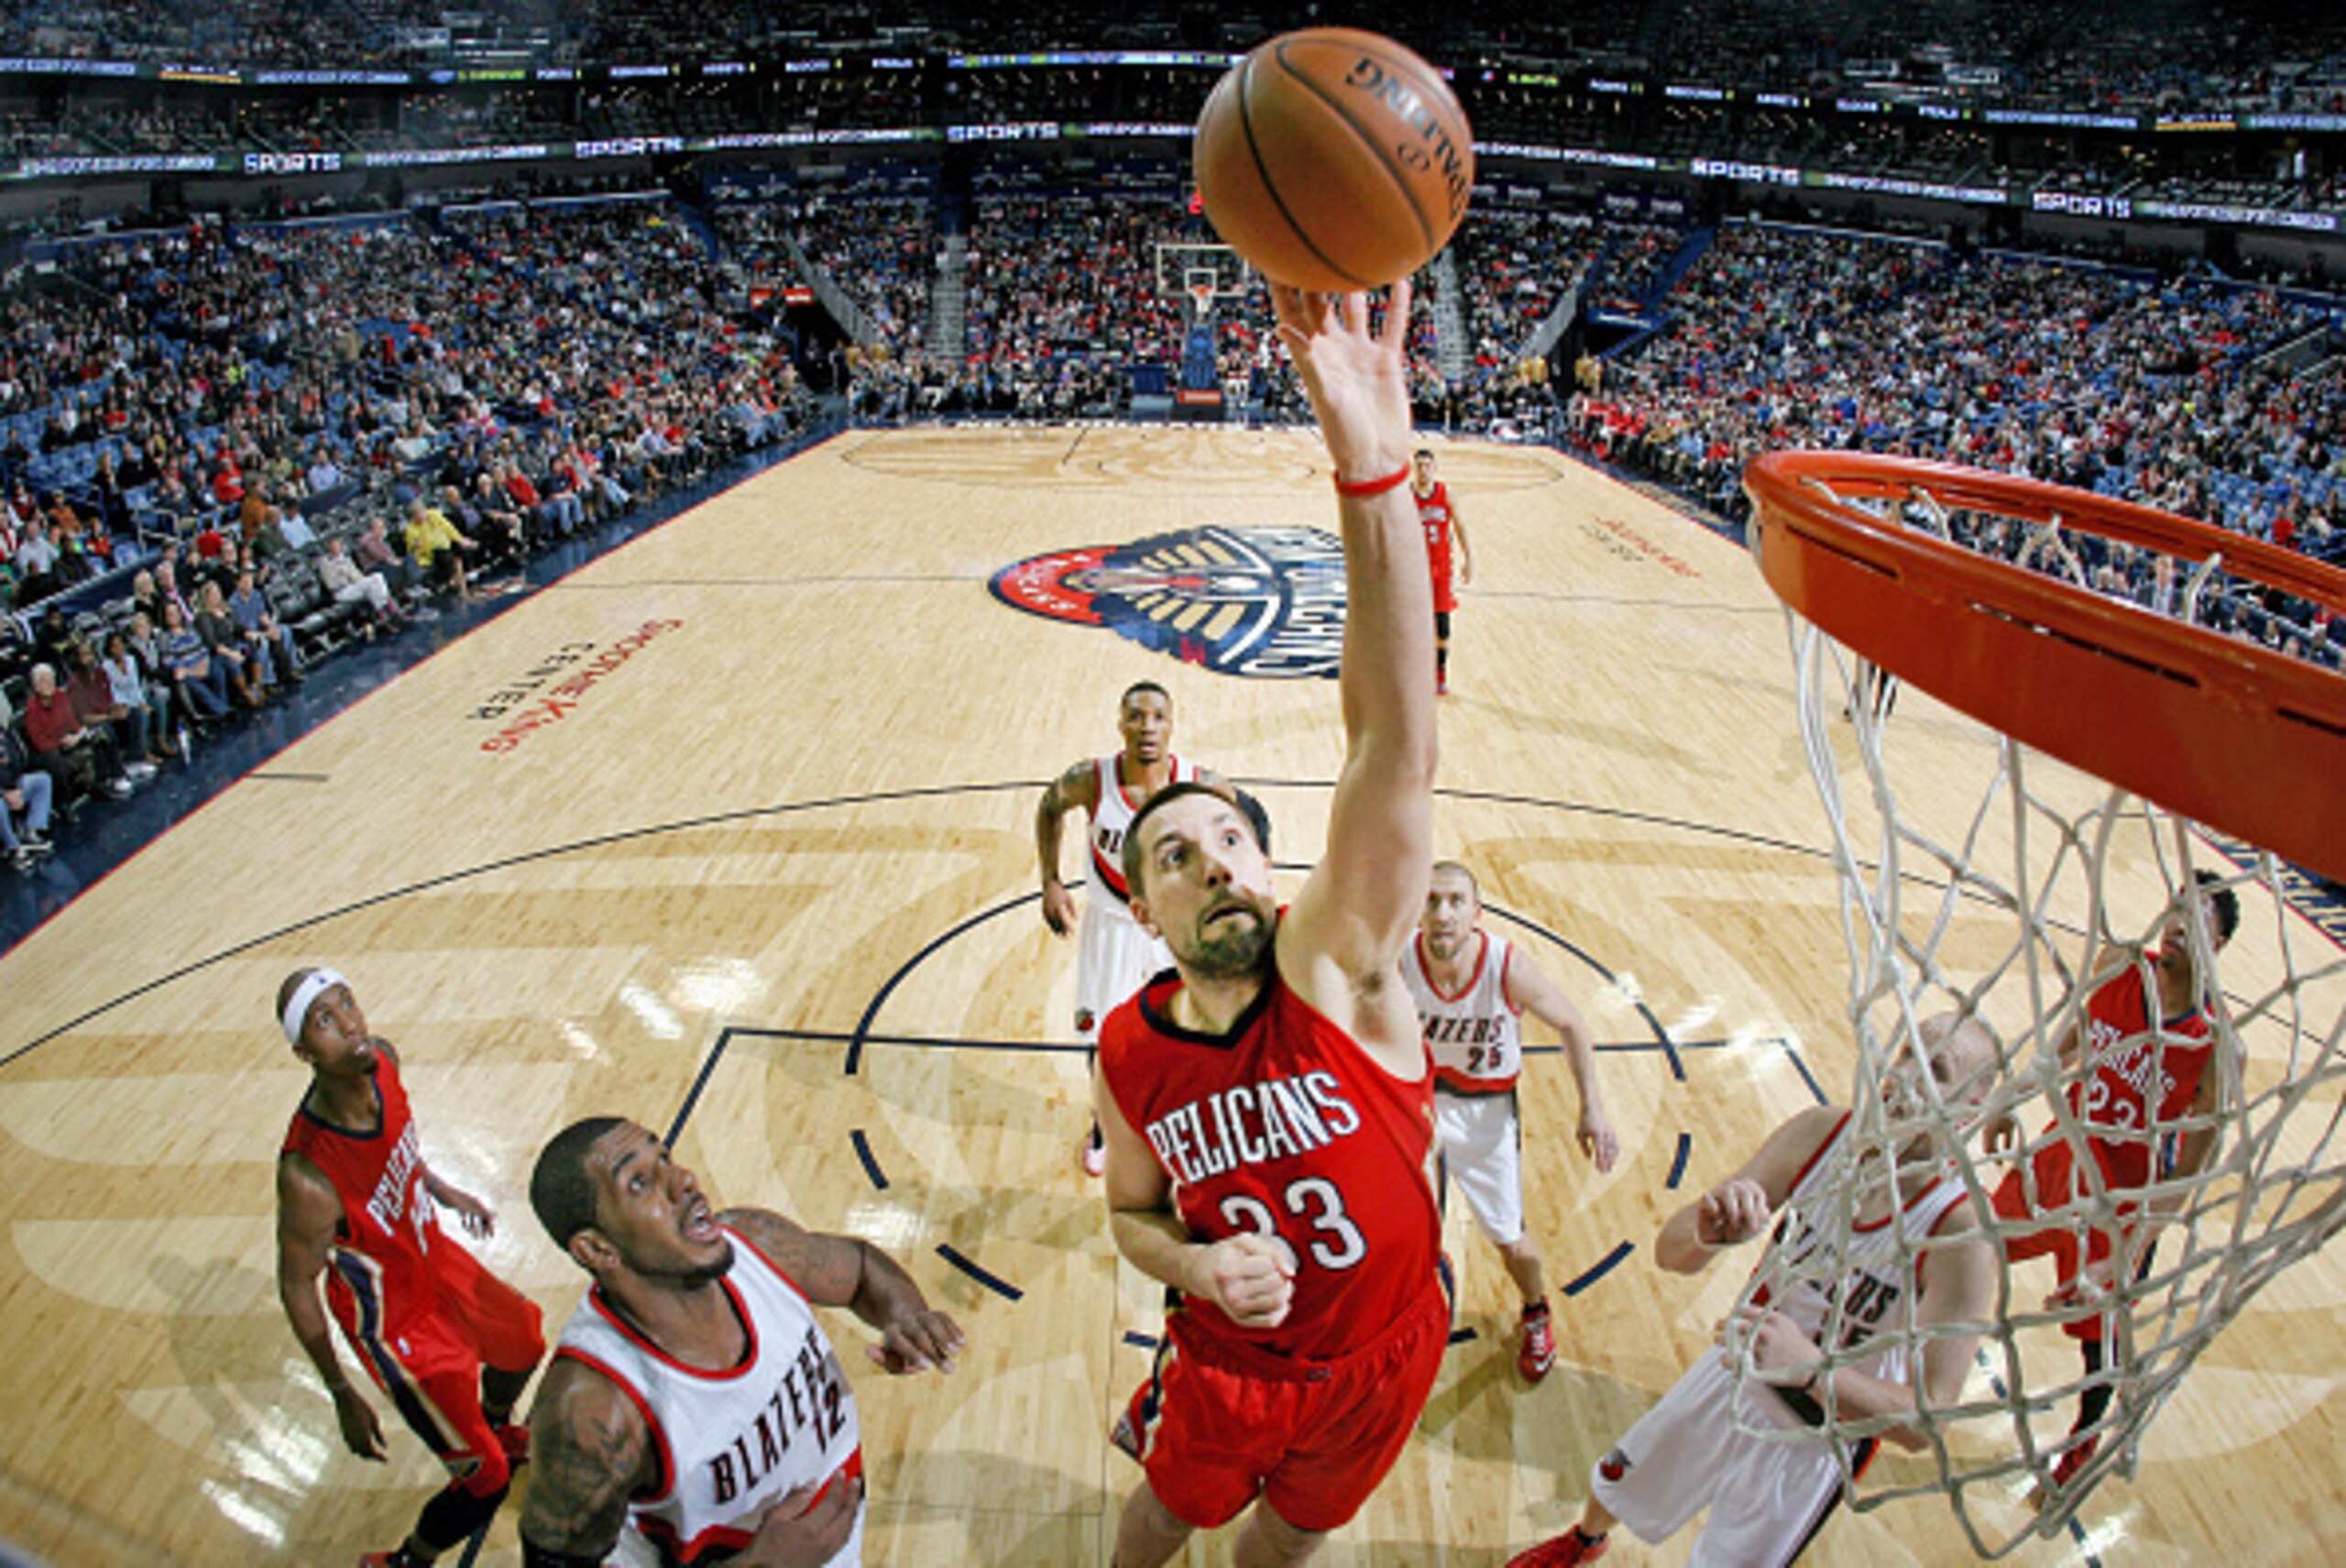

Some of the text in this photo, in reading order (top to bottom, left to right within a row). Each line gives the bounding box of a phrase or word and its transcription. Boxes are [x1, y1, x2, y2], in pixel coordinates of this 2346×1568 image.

[947, 122, 1058, 142] SPORTS
[575, 137, 684, 159] SPORTS
[243, 152, 341, 175] SPORTS
[1690, 157, 1800, 186] SPORTS
[2034, 192, 2132, 219] SPORTS
[465, 641, 596, 720] CENTER
[1466, 1041, 1505, 1073] 25
[1146, 1069, 1361, 1187] PELICANS
[1220, 1177, 1369, 1271] 33
